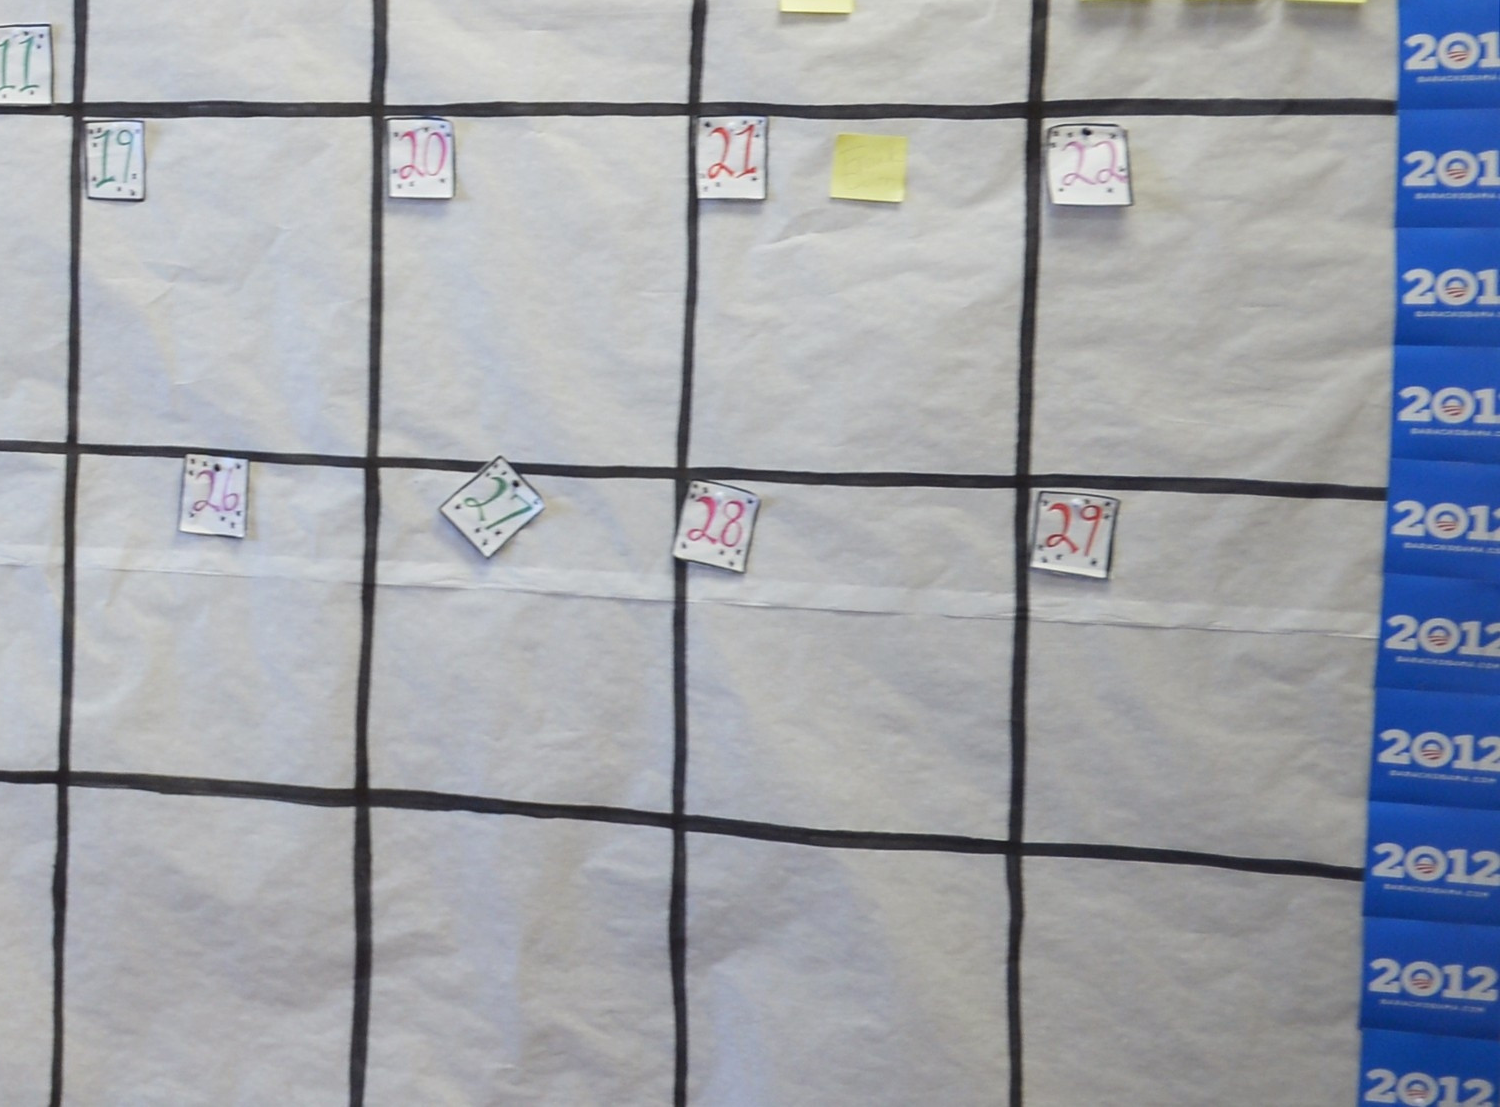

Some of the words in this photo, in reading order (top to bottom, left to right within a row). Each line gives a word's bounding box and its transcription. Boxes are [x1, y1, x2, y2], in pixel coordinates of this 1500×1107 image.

[94, 128, 135, 189] 19
[400, 130, 449, 180] 20
[706, 124, 758, 180] 21
[1062, 140, 1128, 187] 22
[193, 464, 239, 514] 26
[464, 477, 533, 529] 27
[686, 495, 744, 548] 28
[1044, 502, 1103, 558] 29
[1372, 843, 1500, 887] 2012
[1369, 958, 1499, 1002] 2012
